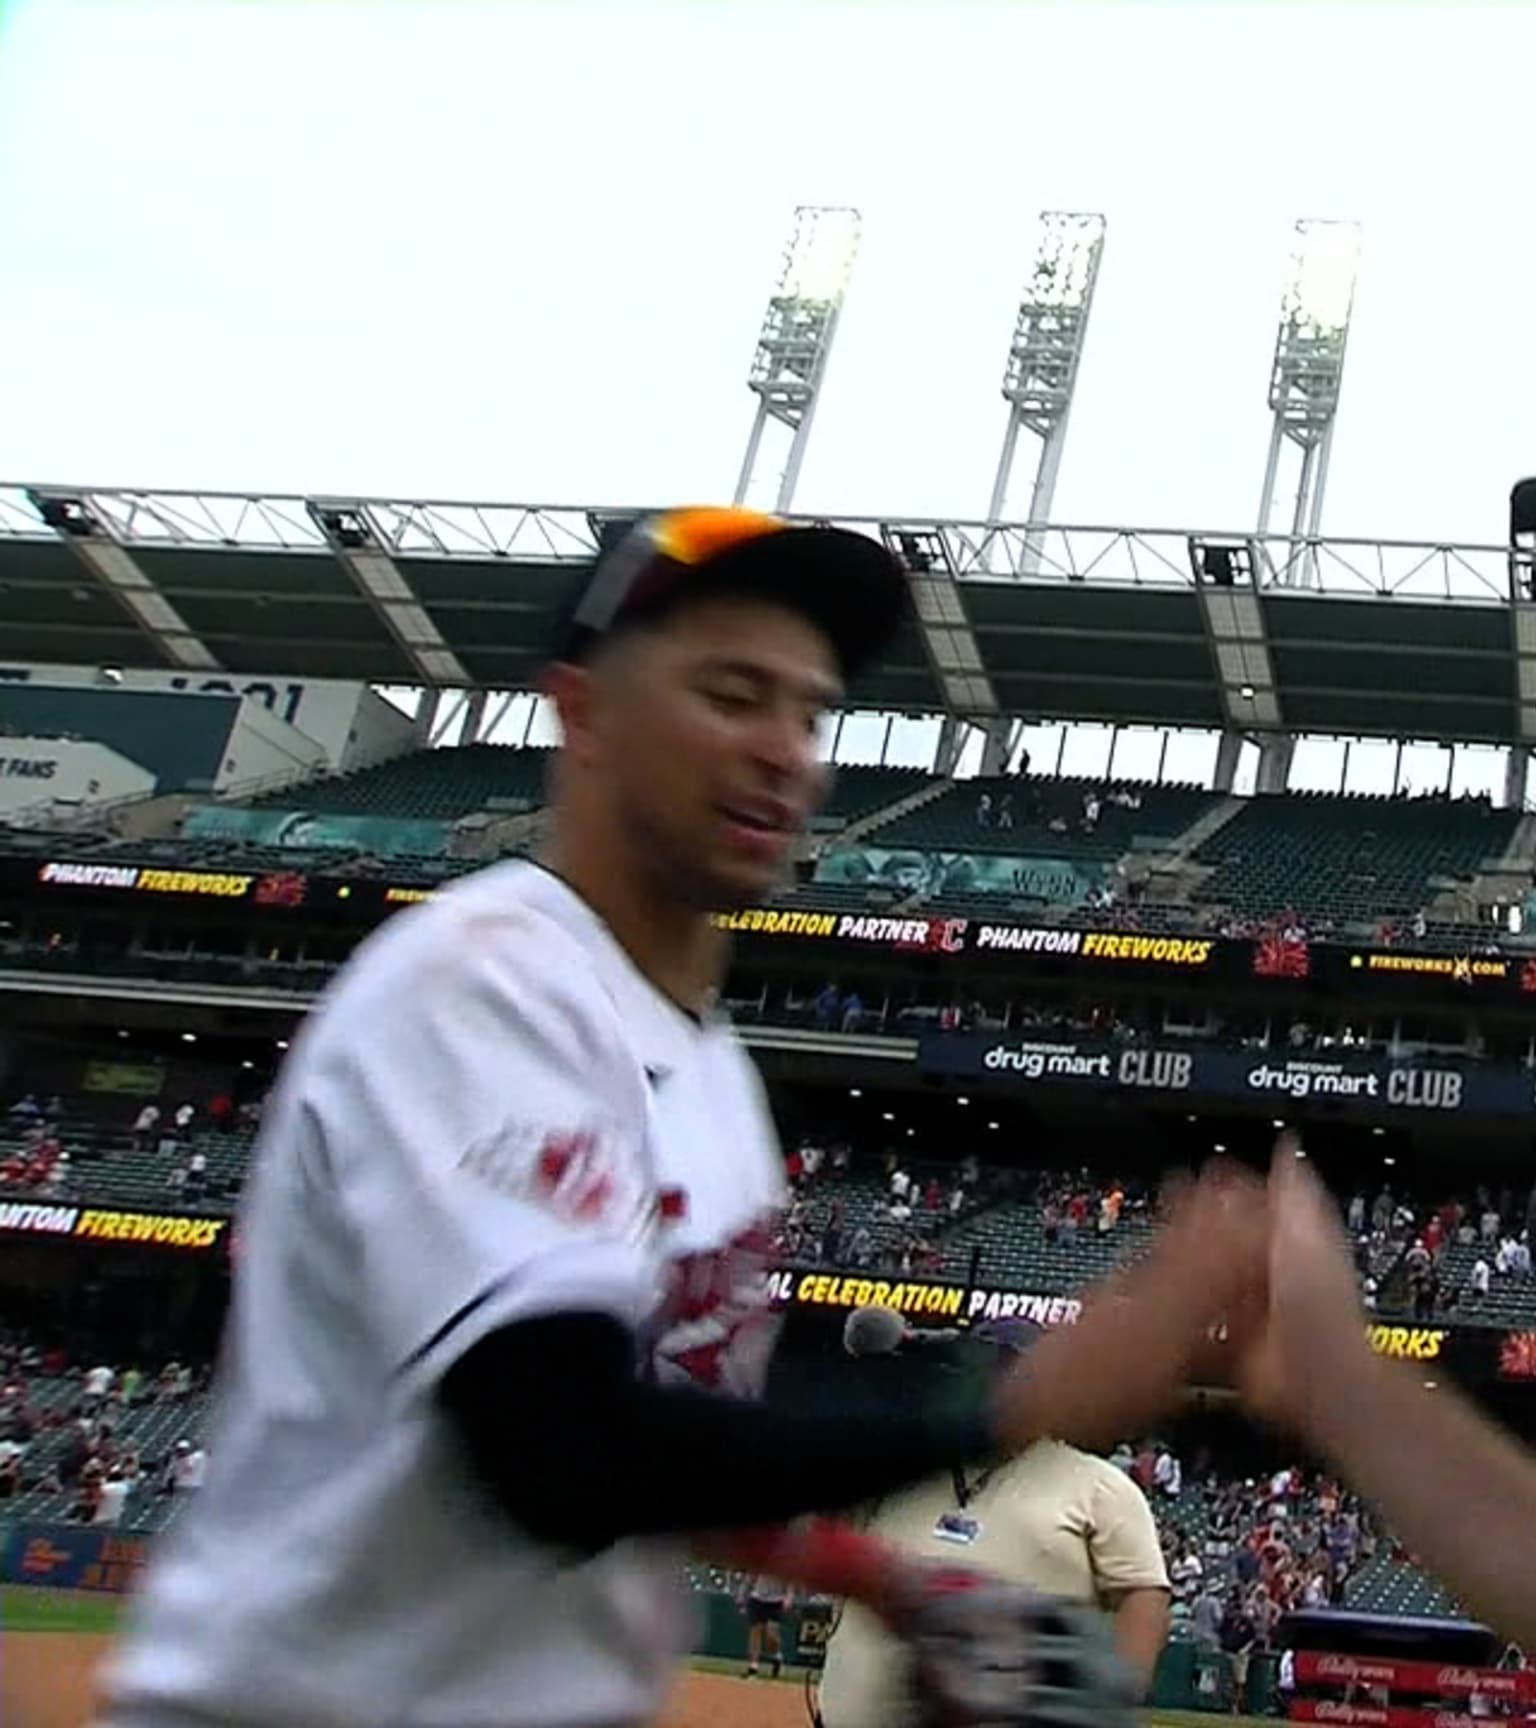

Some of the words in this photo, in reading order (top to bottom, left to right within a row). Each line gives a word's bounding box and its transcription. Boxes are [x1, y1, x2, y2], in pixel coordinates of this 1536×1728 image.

[42, 863, 137, 887] PHANTOM
[135, 870, 252, 896] FIREWORKS
[712, 910, 836, 937] ELEBRATION
[837, 916, 928, 943] PARTNER
[976, 926, 1080, 953] PHANTOM
[1082, 934, 1210, 964] FIREWORKS
[984, 1045, 1045, 1078] drug
[1047, 1054, 1111, 1077] mart
[1118, 1050, 1193, 1089] CLUB
[1248, 1064, 1311, 1097] drug
[1313, 1073, 1378, 1096] mart
[1387, 1068, 1463, 1108] CLUB
[74, 1209, 224, 1248] FIREWORKS
[798, 1274, 964, 1315] CELEBRATION
[967, 1288, 1083, 1327] PARTNER
